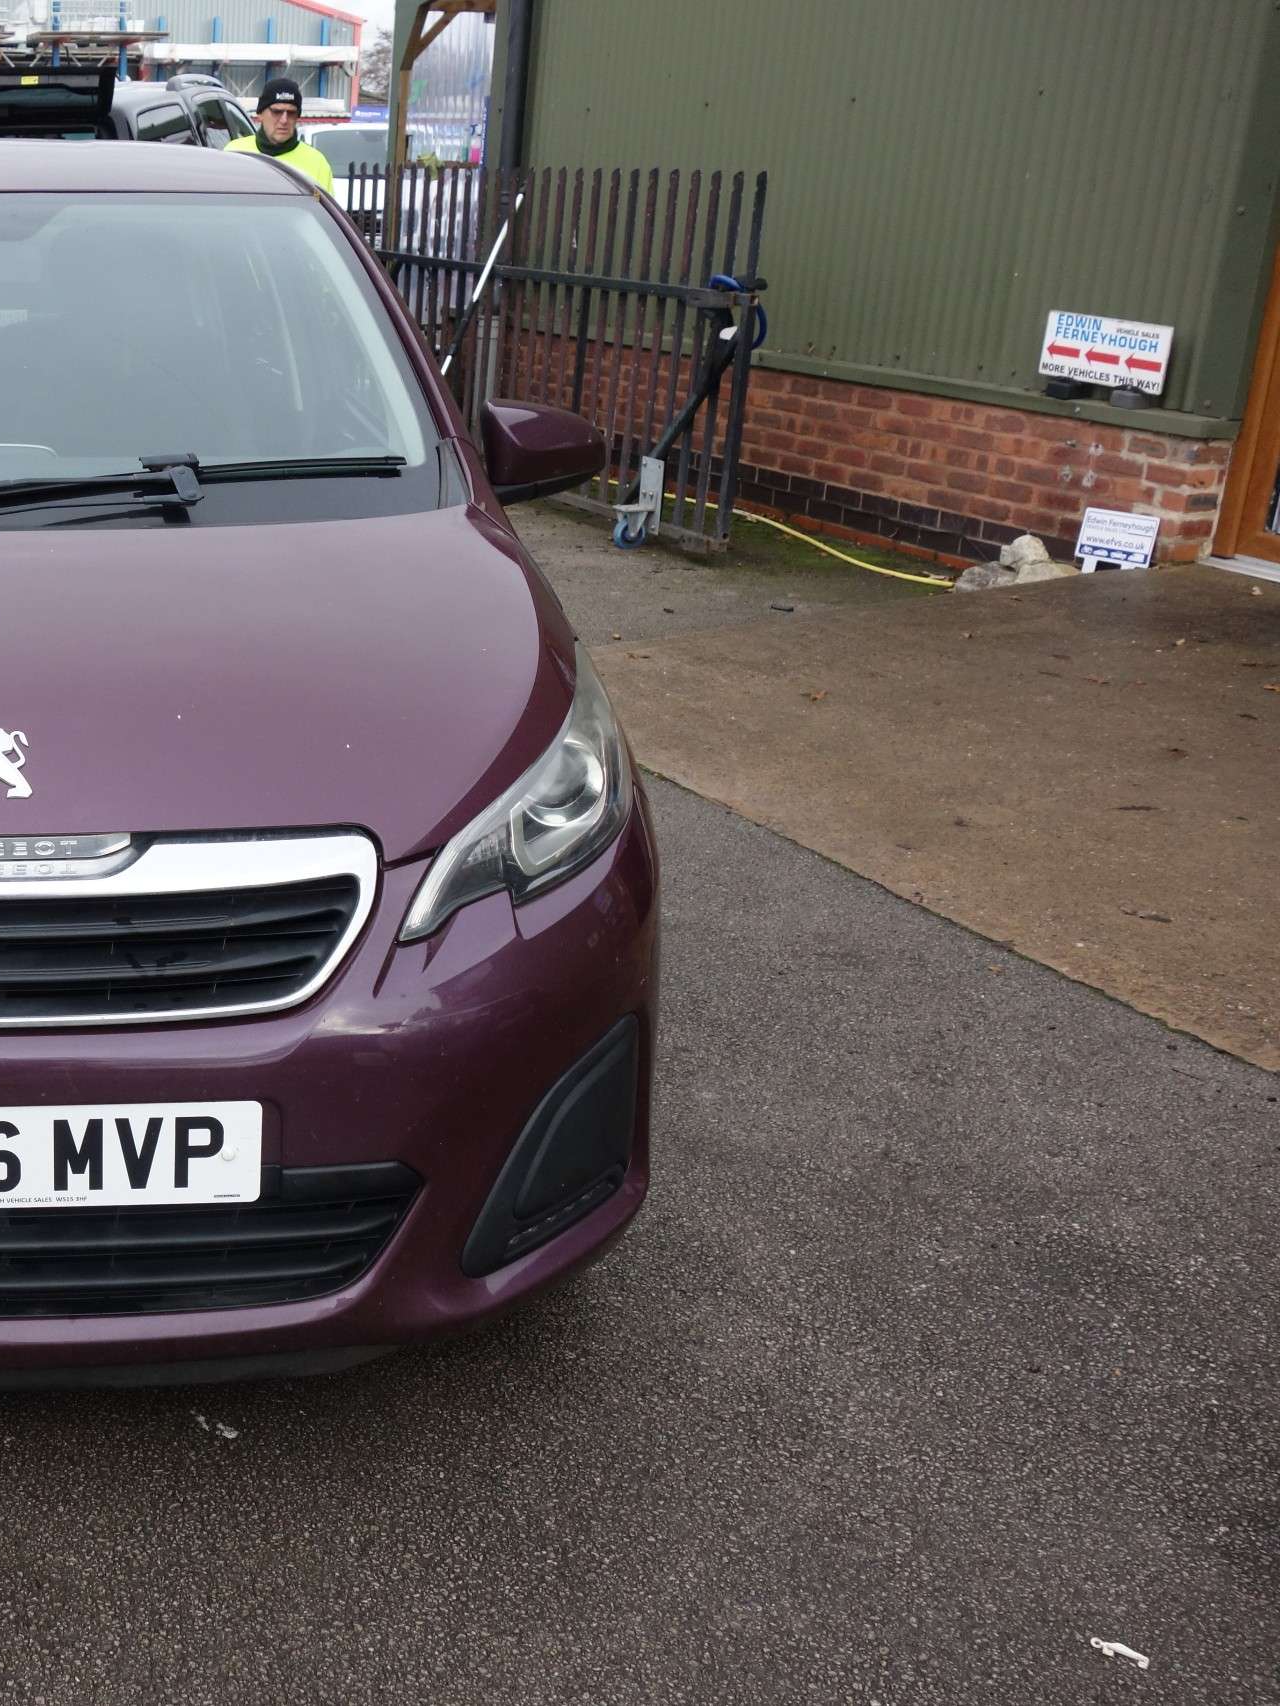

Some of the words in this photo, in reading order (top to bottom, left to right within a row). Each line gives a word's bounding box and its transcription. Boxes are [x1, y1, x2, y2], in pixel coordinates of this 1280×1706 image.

[1057, 313, 1102, 331] EDWIN
[1116, 327, 1140, 337] VEHICLE
[1141, 331, 1160, 340] SALES
[1055, 326, 1159, 354] FERNEYHOUGH
[1041, 361, 1065, 373] MORE
[1068, 366, 1111, 382] VEHICLES
[1114, 375, 1134, 386] THIS
[1135, 379, 1160, 392] WAY!
[1109, 519, 1155, 534] Ferneyhough
[52, 1116, 225, 1191] MVP
